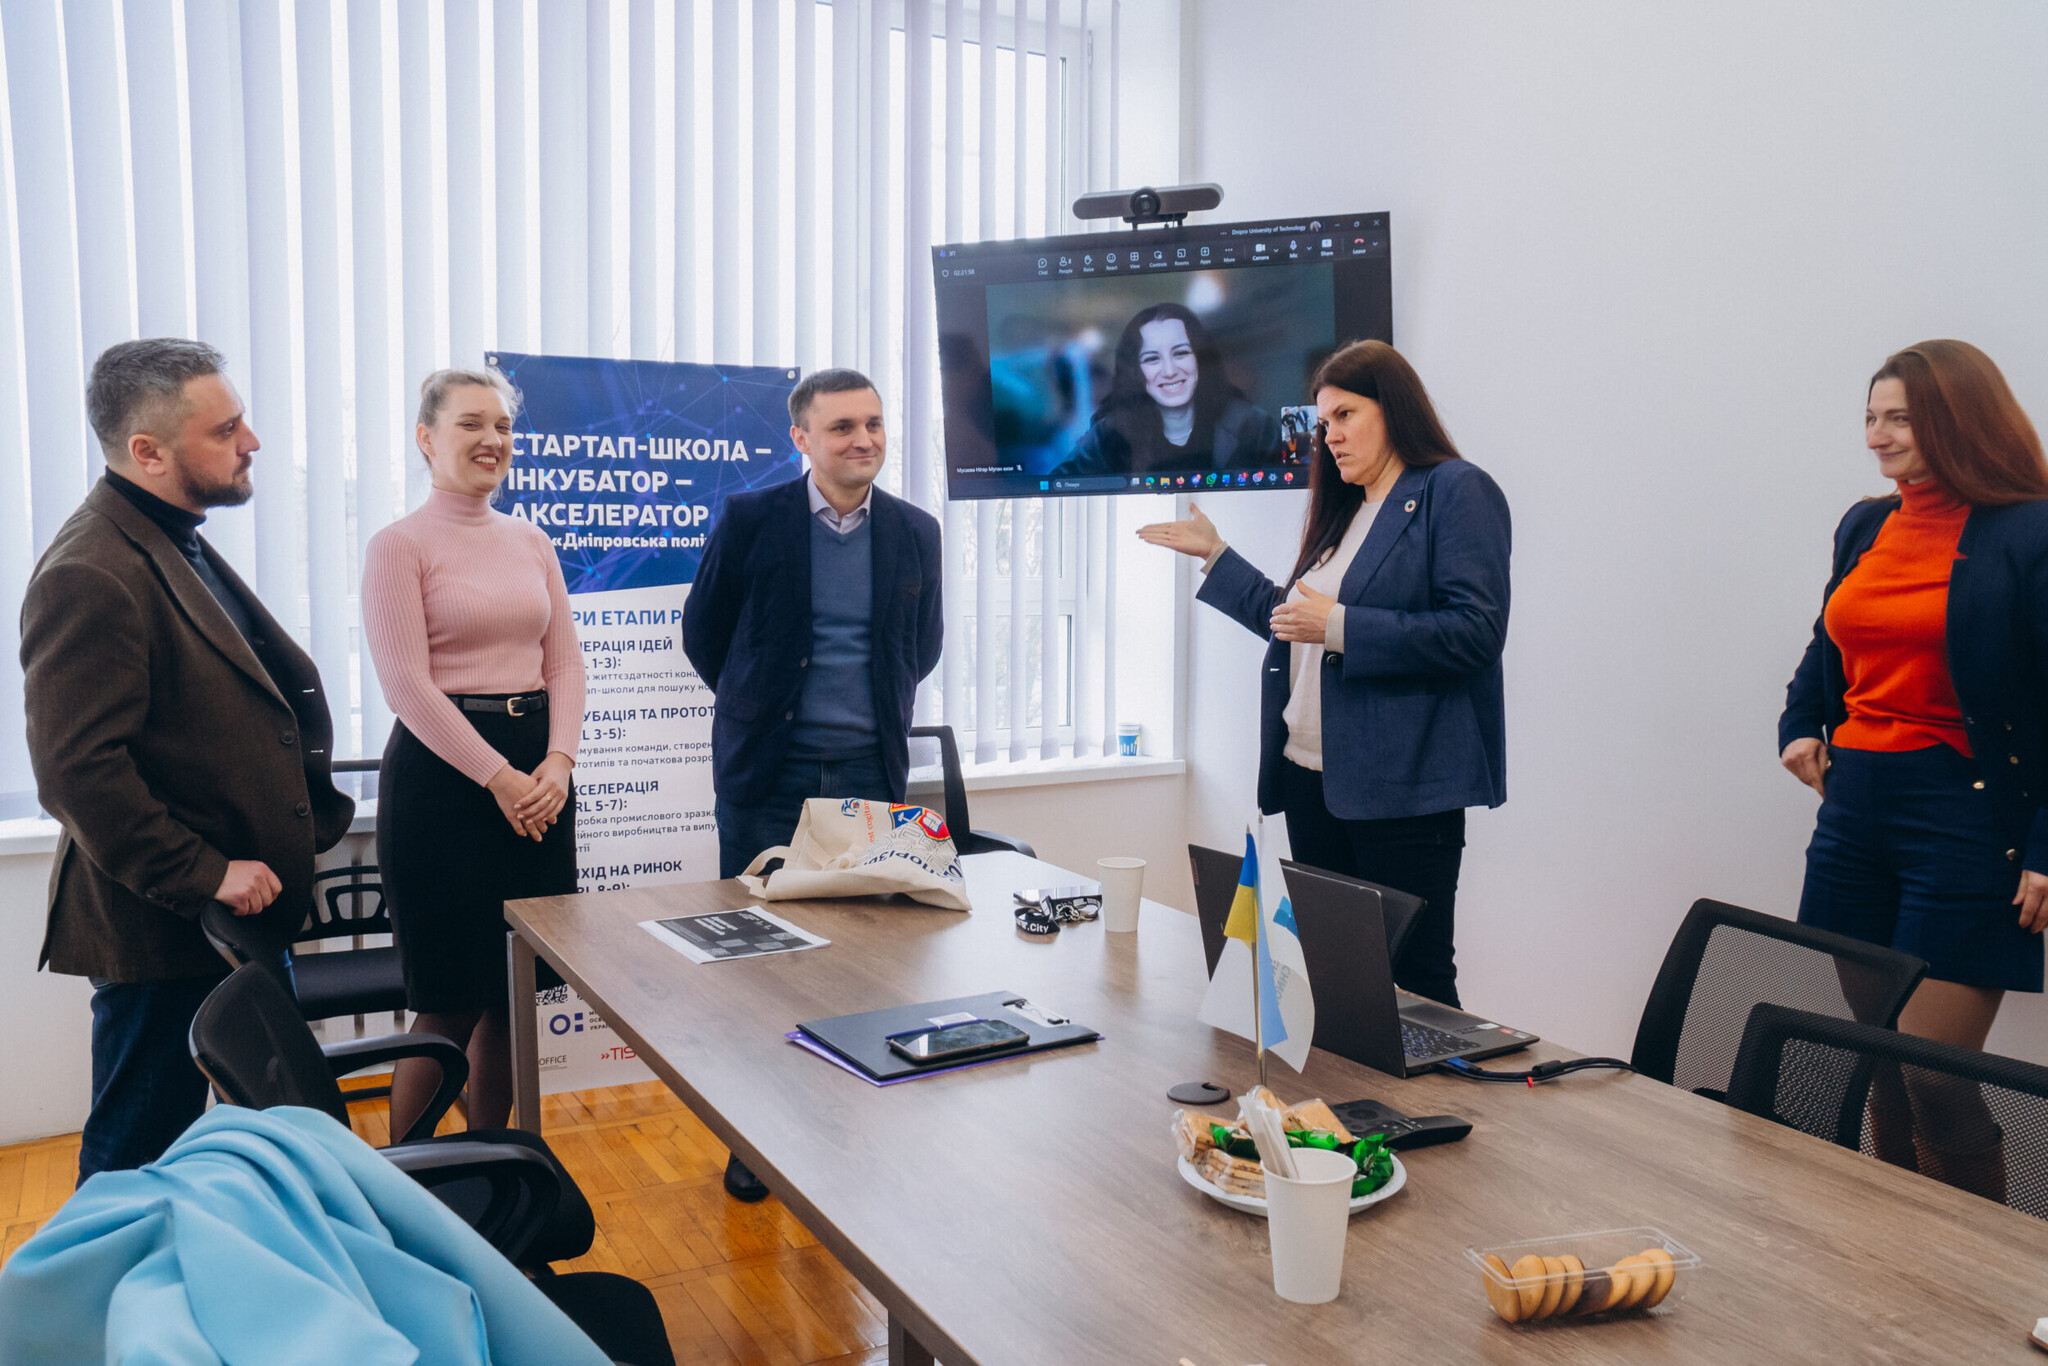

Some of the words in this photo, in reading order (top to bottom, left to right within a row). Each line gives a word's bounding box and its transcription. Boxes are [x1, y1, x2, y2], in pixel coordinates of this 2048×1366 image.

[512, 432, 750, 462] СТАРТАП-ШКОЛА
[508, 468, 668, 493] ІНКУБАТОР
[510, 502, 709, 527] АКСЕЛЕРАТОР
[671, 532, 706, 548] полі
[572, 611, 596, 626] РИ
[602, 610, 666, 626] ЕТАПИ
[671, 610, 682, 624] Р
[580, 640, 635, 653] ЕРАЦІЯ
[639, 636, 673, 653] ІДЕЙ
[592, 656, 621, 669] 1-3):
[592, 669, 673, 681] життєздатності
[675, 671, 700, 679] конц
[637, 686, 656, 694] для
[658, 684, 696, 694] пошуку
[584, 710, 636, 723] УБАЦІЯ
[640, 708, 657, 720] ТА
[661, 706, 715, 719] ПРОТОТ
[594, 727, 626, 740] 3-5):
[578, 746, 623, 755] мування
[625, 744, 671, 752] команди,
[674, 742, 712, 751] створен
[577, 759, 615, 768] тотипів
[631, 758, 682, 766] початкова
[685, 755, 713, 764] розро
[574, 780, 659, 796] КСЕЛЕРАЦІЯ
[576, 802, 591, 812] RL
[596, 799, 627, 811] 5-7):
[577, 817, 608, 827] робка
[610, 812, 682, 825] промислового
[864, 800, 874, 830] cogitar
[577, 830, 609, 839] ійного
[612, 826, 678, 838] виробництва
[693, 823, 716, 832] випу
[576, 843, 590, 852] тії
[610, 865, 630, 876] НА
[634, 860, 682, 875] РИНОК
[539, 1055, 567, 1065] OFFICE
